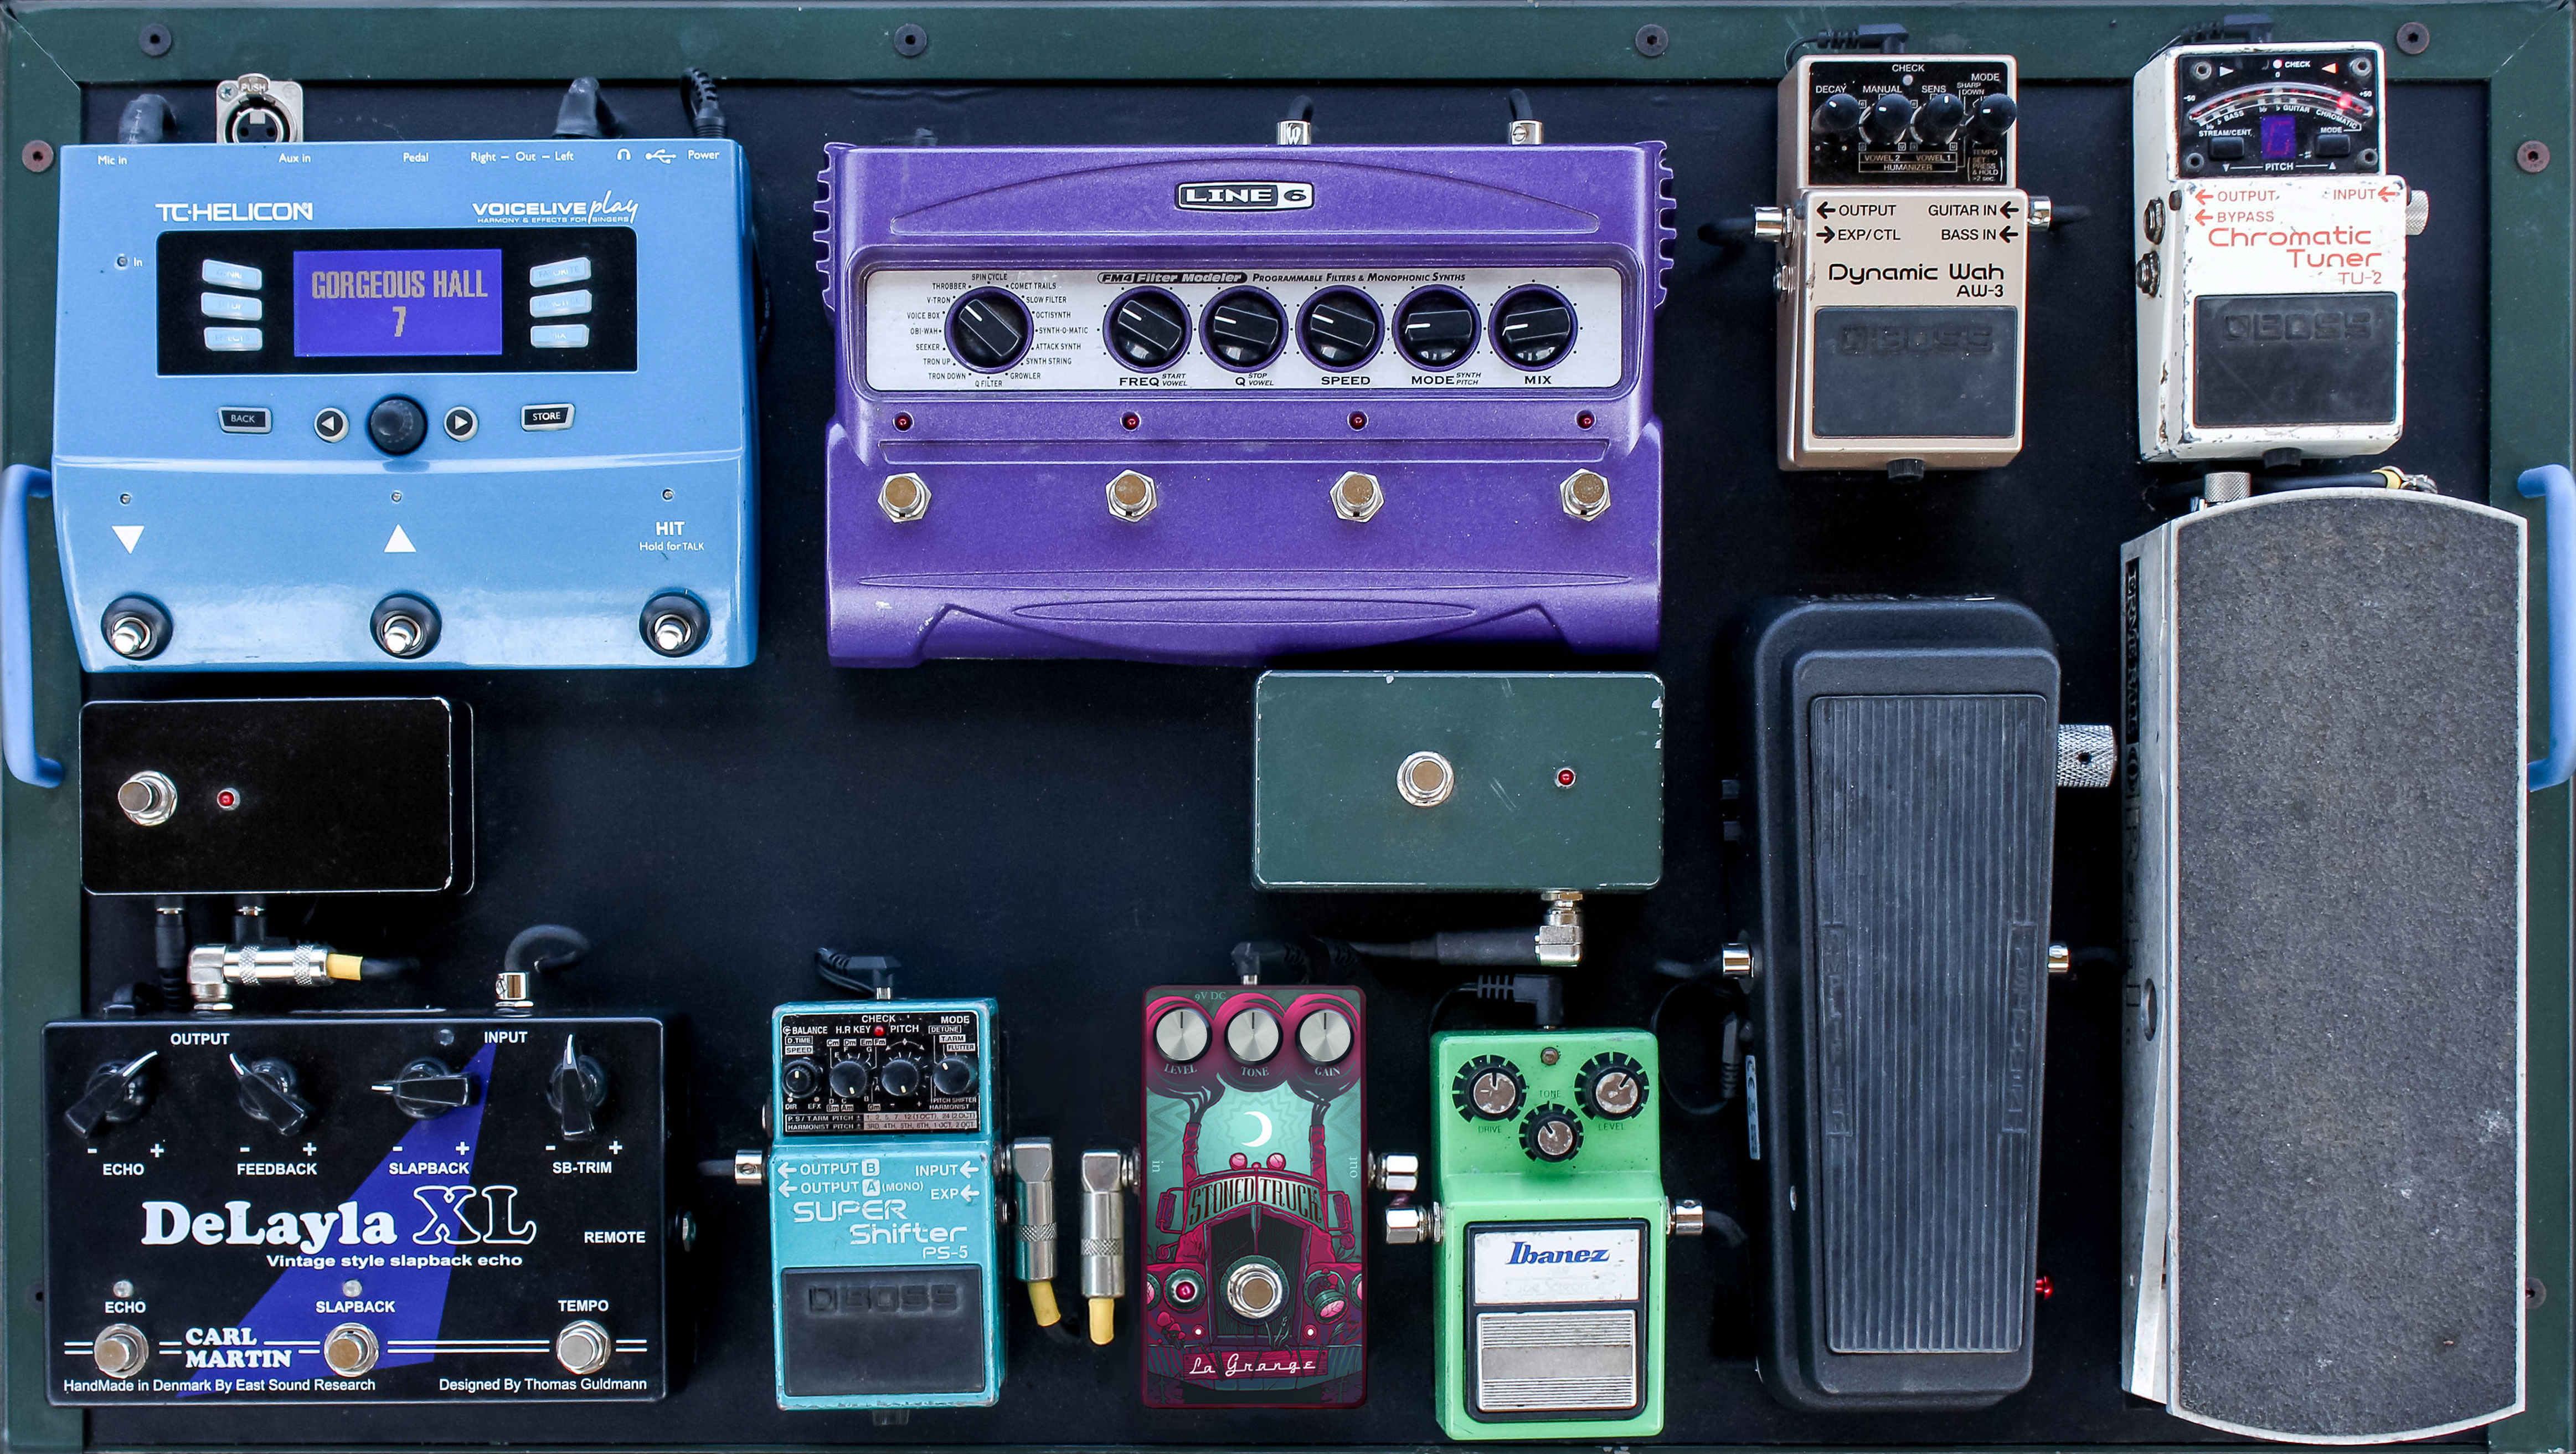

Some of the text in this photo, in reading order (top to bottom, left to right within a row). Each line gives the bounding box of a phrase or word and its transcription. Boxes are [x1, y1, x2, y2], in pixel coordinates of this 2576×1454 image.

[1971, 73, 2000, 81] MODE
[241, 83, 266, 92] PUSH
[1815, 85, 1846, 94] DECAY
[1921, 85, 1946, 93] SENS
[2283, 105, 2310, 113] GUITAR
[98, 155, 127, 165] Mic in
[279, 153, 311, 163] Aux in
[403, 152, 429, 162] Pedal
[471, 151, 574, 163] Right Out Left
[688, 150, 720, 161] Power
[2265, 163, 2294, 171] PITCH
[1186, 189, 1307, 203] LINE 6
[2218, 191, 2276, 202] OUTPUT
[2333, 189, 2376, 200] INPUT
[472, 189, 638, 224] VOICELIVE play
[1839, 204, 1897, 216] OUTPUT
[1928, 204, 1997, 216] GUITAR IN
[2217, 211, 2274, 223] BYPASS
[1838, 228, 1900, 241] EXP/CTL
[1941, 229, 1996, 240] BASS IN
[2208, 225, 2371, 246] Chromatic
[133, 257, 143, 267] In
[2286, 249, 2382, 268] Tuner
[1101, 273, 1241, 282] FM4 Filter Modeler
[1828, 263, 2004, 285] Dynamic Wah
[2338, 272, 2382, 285] TU-2
[311, 270, 488, 299] GORGEOUS HALL
[1956, 284, 2003, 297] AW-3
[391, 306, 406, 337] 7
[1119, 377, 1160, 387] FREQ
[1235, 377, 1246, 387] Q
[1321, 375, 1371, 385] SPEED
[1411, 375, 1455, 384] MODE
[1524, 375, 1552, 384] MIX
[230, 413, 256, 424] BACK
[532, 410, 561, 422] STORE
[656, 521, 684, 536] HIT
[639, 541, 704, 552] Hold for TALK
[1195, 991, 1226, 1001] 9V DC
[861, 1015, 896, 1023] CHECK
[792, 1026, 828, 1035] BALANCE
[853, 1025, 871, 1034] KEY
[890, 1025, 919, 1033] PITCH
[170, 1033, 230, 1045] OUTPUT
[484, 1031, 528, 1044] INPUT
[1164, 1063, 1197, 1075] LEVEL
[1240, 1066, 1269, 1077] TONE
[1314, 1066, 1341, 1077] GAIN
[1538, 1090, 1562, 1098] TONE
[1598, 1123, 1625, 1131] LEVEL
[102, 1163, 145, 1175] ECHO
[237, 1163, 317, 1175] FEEDBACK
[389, 1162, 470, 1175] SLAPBACK
[553, 1162, 612, 1174] SB-TRIM
[800, 1161, 875, 1175] OUTPUT B
[915, 1164, 959, 1176] INPUT
[801, 1180, 924, 1194] OUTPUT A (MONO)
[931, 1188, 959, 1200] EXP
[1189, 1177, 1322, 1225] STONED TRUCK
[793, 1199, 908, 1222] SUPER
[141, 1185, 537, 1255] DeLayla XL
[584, 1231, 646, 1244] REMOTE
[849, 1222, 967, 1245] Shifter
[923, 1245, 968, 1260] PS-5
[1505, 1241, 1611, 1265] Ibanez
[266, 1254, 523, 1270] Vintage style slapback echo
[105, 1301, 146, 1313] ECHO
[316, 1301, 395, 1313] SLAPBACK
[558, 1299, 609, 1312] TEMPO
[185, 1328, 257, 1345] CARL
[185, 1350, 292, 1368] MARTIN
[1189, 1353, 1316, 1376] La Grange
[64, 1379, 375, 1394] HandMade in Denmark By East Sound Research
[439, 1378, 647, 1393] Designed By Thomas Guldmann
